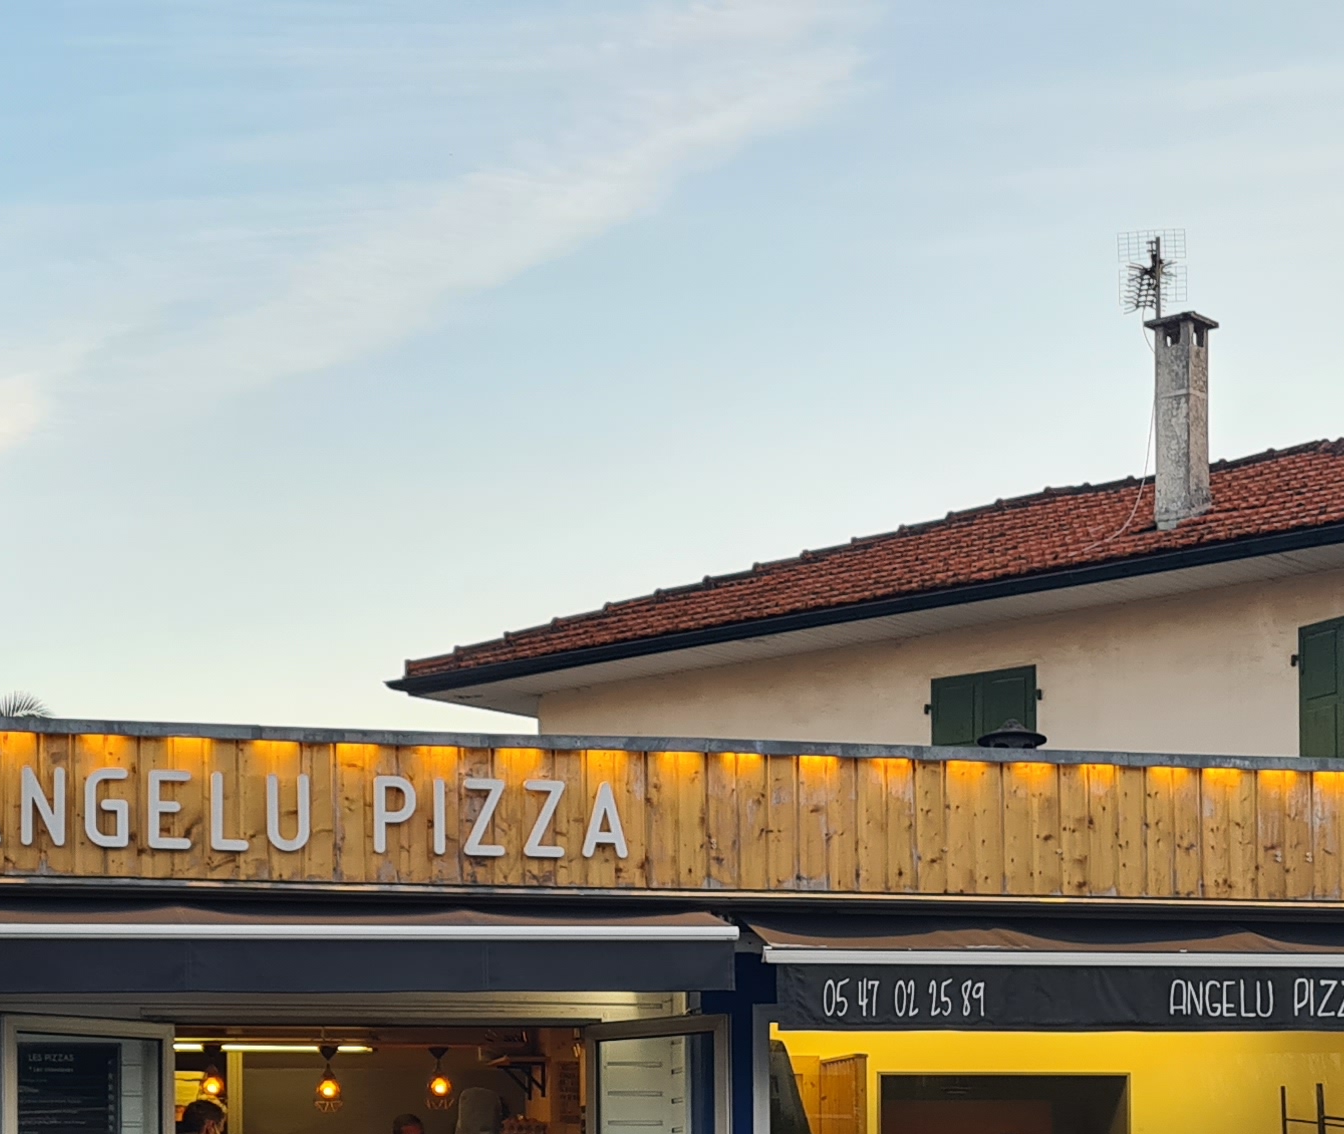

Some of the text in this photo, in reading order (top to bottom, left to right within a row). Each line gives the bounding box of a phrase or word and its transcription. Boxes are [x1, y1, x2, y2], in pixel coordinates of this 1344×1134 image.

[372, 774, 630, 859] PIZZA
[823, 977, 985, 1017] 05 47 02 25 89
[1168, 979, 1274, 1018] ANGELU
